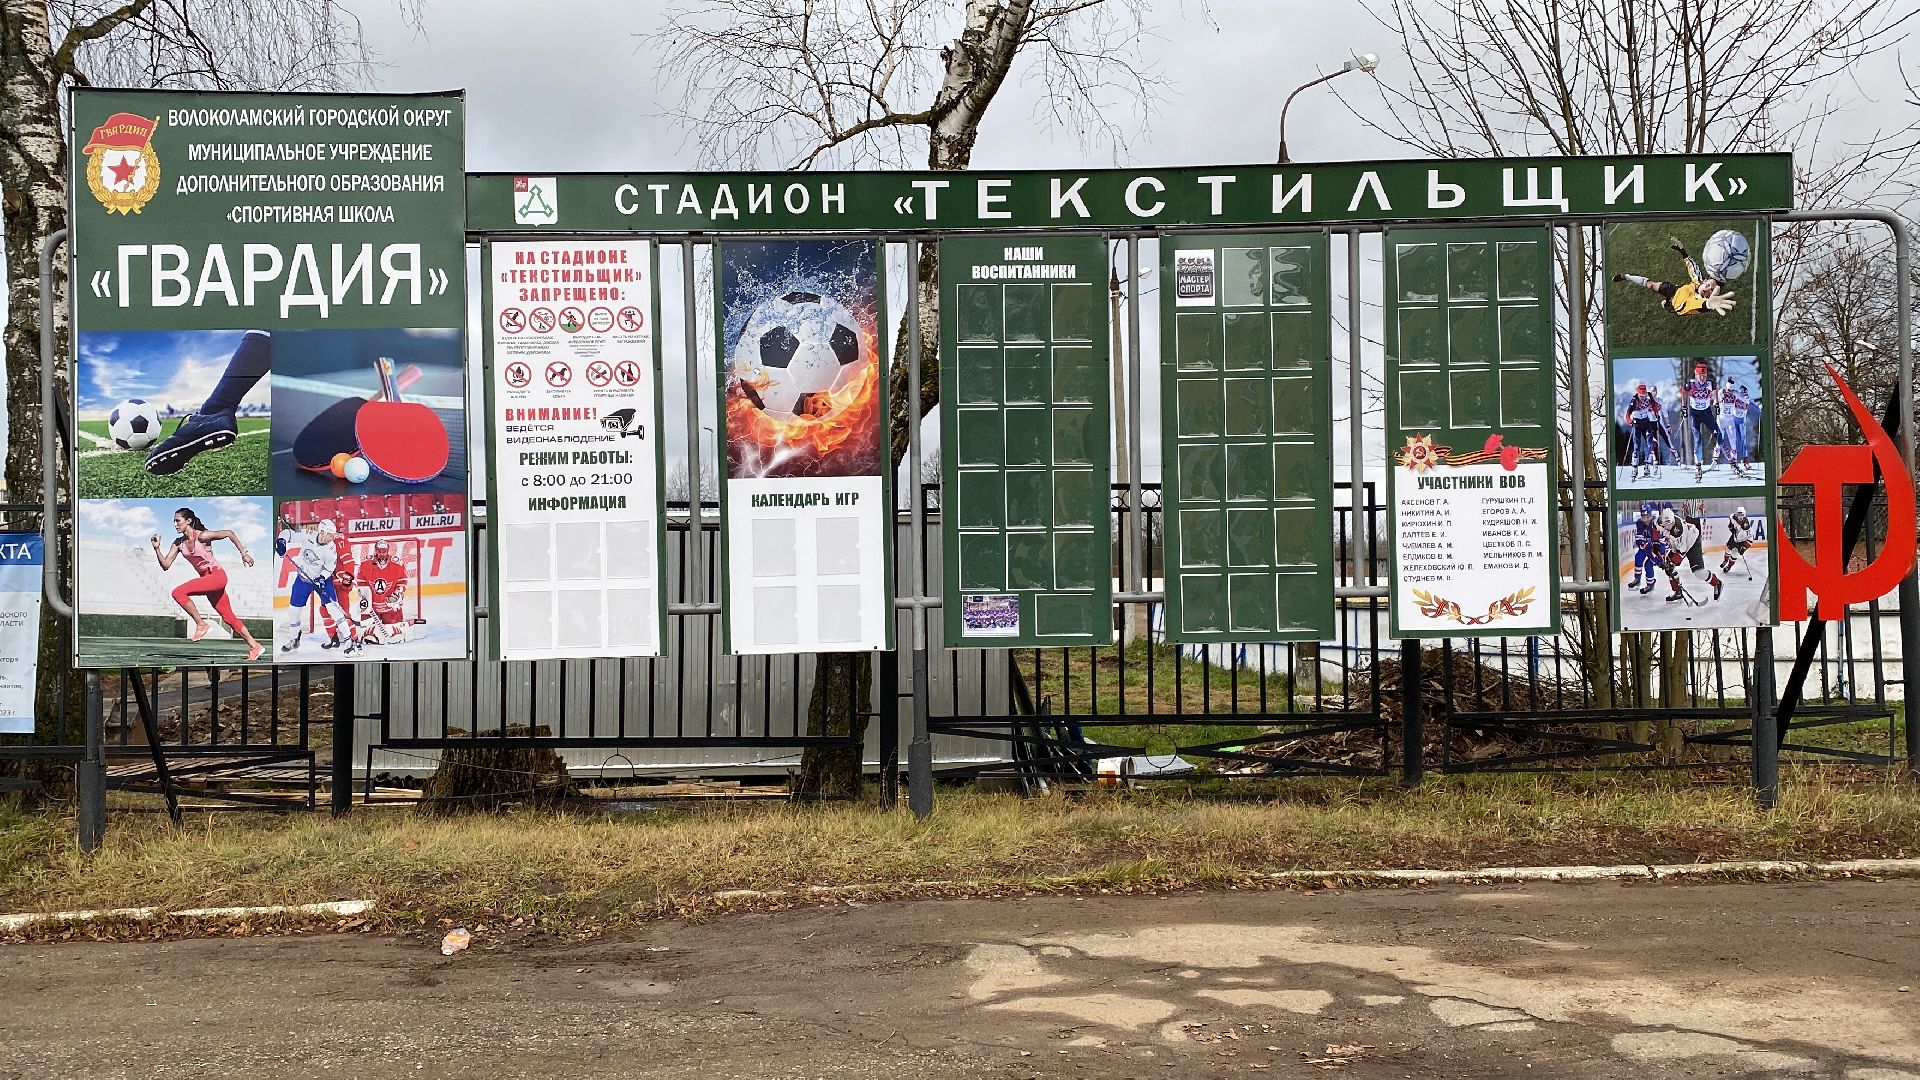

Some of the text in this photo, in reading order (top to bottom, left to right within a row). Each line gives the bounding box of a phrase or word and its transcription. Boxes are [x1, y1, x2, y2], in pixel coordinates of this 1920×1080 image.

[168, 104, 452, 129] ВОЛОКОЛАМСКИЙ ГОРОДСКОЙ ОКРУГ
[99, 124, 148, 139] ГВАРДИЯ
[188, 144, 433, 163] МУНИЦИПАЛЬНОЕ УЧРЕЖДЕНИЕ
[176, 174, 444, 195] ДОПОЛНИТЕЛЬНОГО ОБРАЗОВАНИЯ
[614, 162, 1748, 221] СТАДИОН «ТЕКСТИЛЬЩИК»
[226, 205, 395, 223] «СПОРТИВНАЯ ШКОЛА
[515, 250, 628, 266] НА СТАДИОНЕ
[1004, 246, 1044, 261] НАШИ
[501, 268, 642, 284] «ТЕКСТИЛЬЩИК»
[971, 264, 1076, 279] ВОСПИТАННИКИ
[90, 243, 449, 318] «ГВАРДИЯ»
[1180, 275, 1210, 284] МАСТЕР
[519, 287, 626, 302] ЗАПРЕЩЕНО:
[1180, 284, 1210, 293] СПОРТА
[505, 407, 597, 421] ВНИМАНИЕ!
[506, 435, 616, 445] ВИДЕОНАБЛЮДЕНИЕ
[519, 450, 633, 466] РЕЖИМ РАБОТЫ:
[533, 474, 566, 487] 8:00
[570, 476, 586, 488] до
[590, 473, 633, 485] 21:00
[1417, 474, 1526, 490] УЧАСТНИКИ ВОВ
[528, 496, 627, 511] ИНФОРМАЦИЯ
[751, 492, 860, 508] КАЛЕНДАРЬ ИГР
[354, 518, 394, 532] KHL.RU
[416, 515, 455, 527] KHL.RU
[1401, 531, 1431, 539] ЛАПТЕВ
[1483, 551, 1526, 559] МЕЛЬНИКОВ
